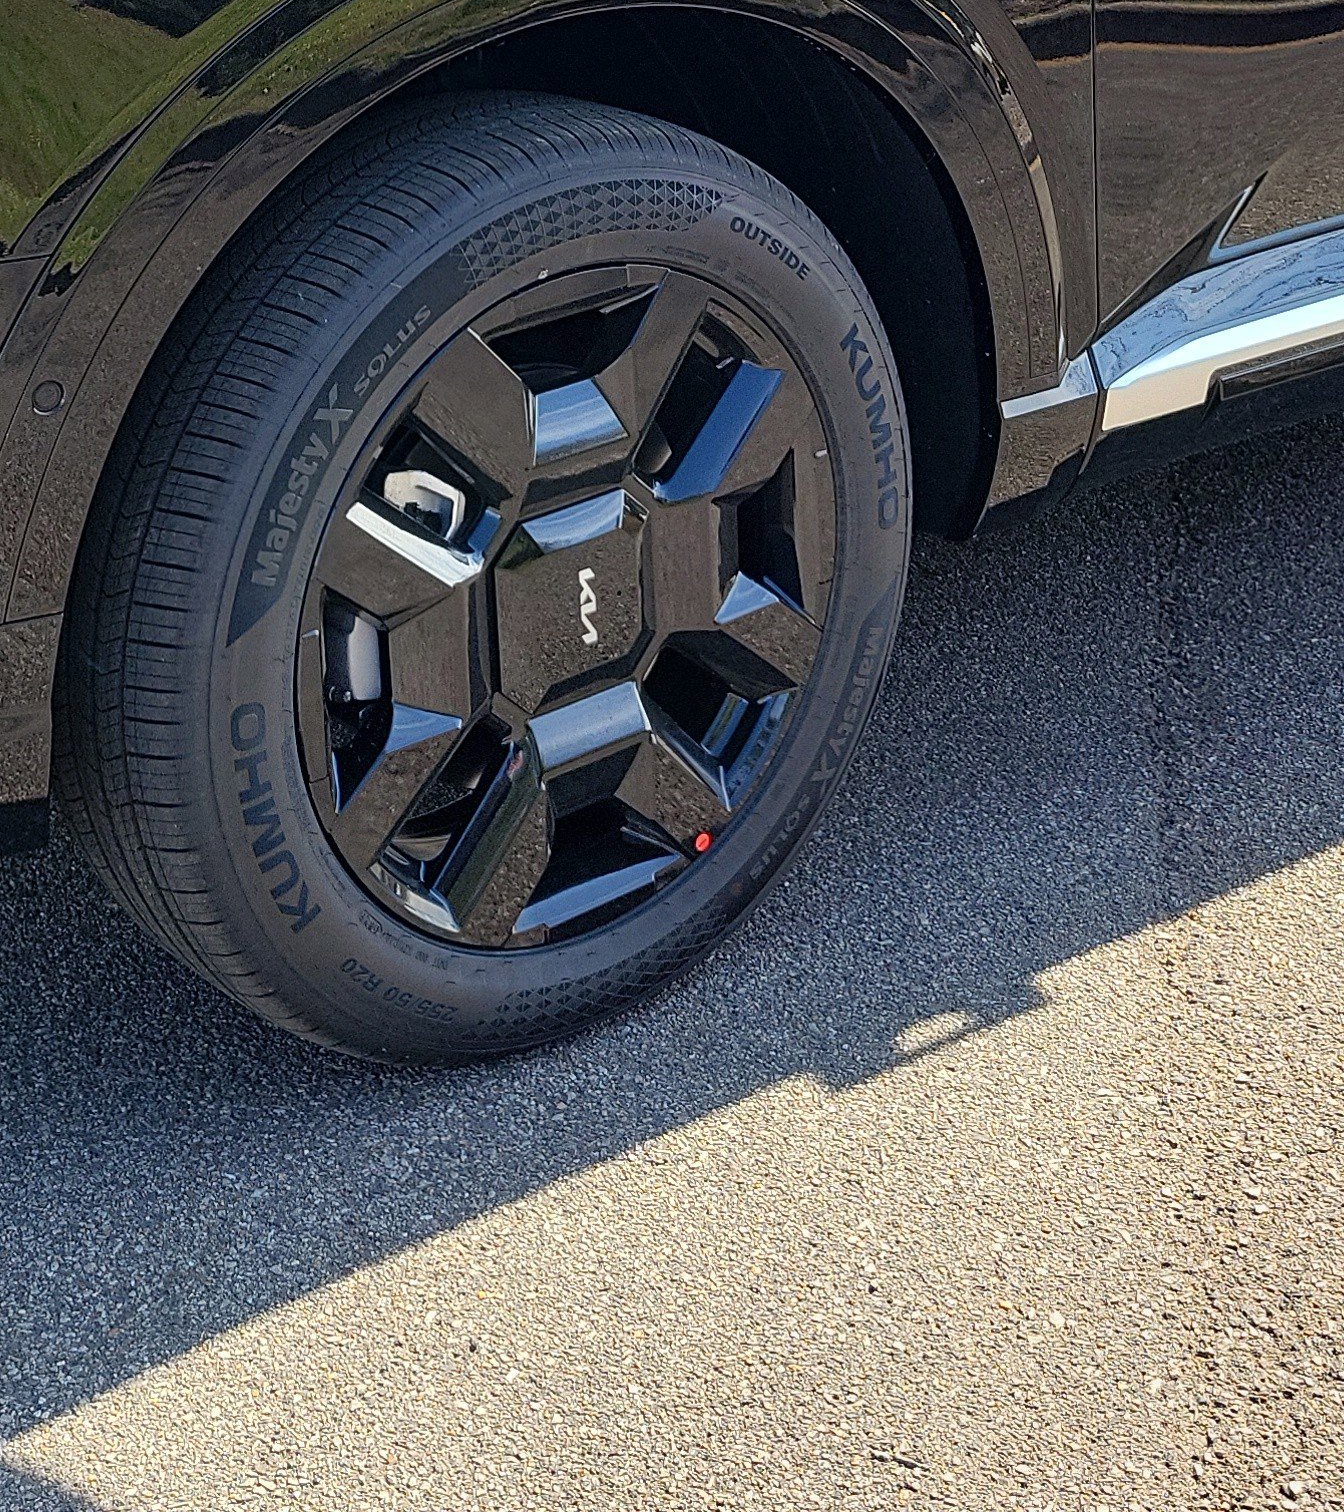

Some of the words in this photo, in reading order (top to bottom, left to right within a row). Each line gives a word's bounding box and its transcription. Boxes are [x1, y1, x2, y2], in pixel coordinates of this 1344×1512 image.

[729, 216, 810, 281] OUTSIDE
[840, 322, 899, 530] KUMHO
[251, 432, 330, 587] Majesty
[229, 701, 322, 934] KUMHO
[340, 957, 383, 992] R20
[383, 986, 457, 1022] 255/50
